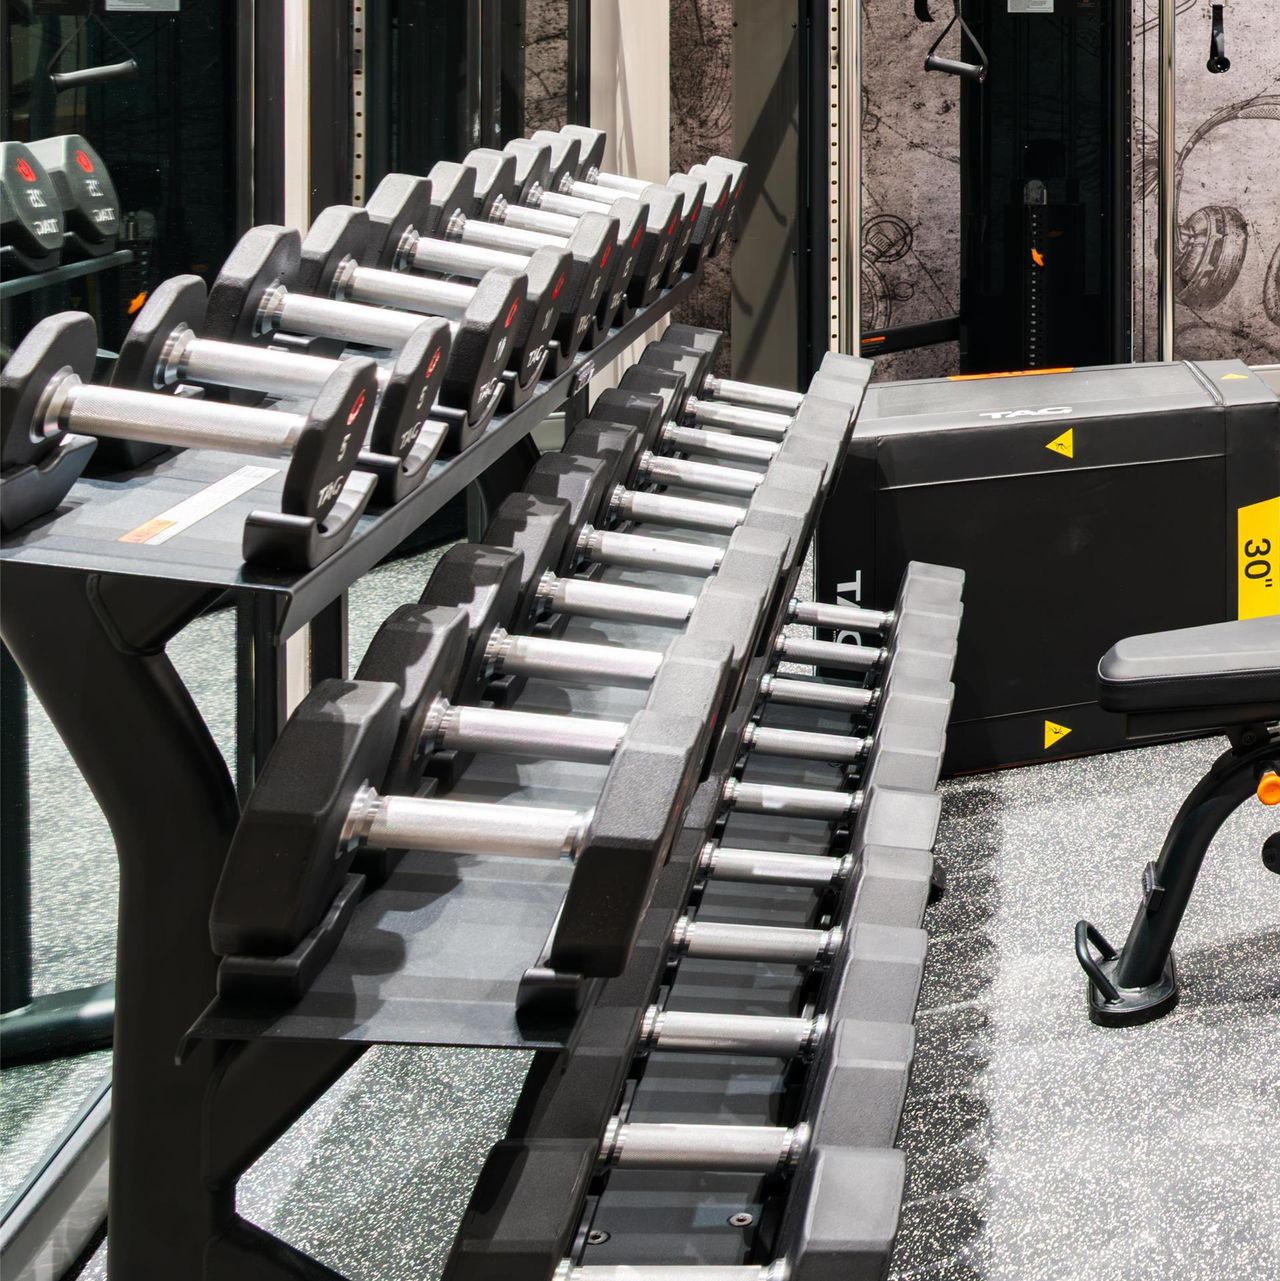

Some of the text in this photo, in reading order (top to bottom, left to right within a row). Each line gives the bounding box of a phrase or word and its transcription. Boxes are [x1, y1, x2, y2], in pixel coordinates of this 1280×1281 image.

[416, 385, 428, 410] 5
[979, 406, 1073, 419] TAG
[336, 432, 352, 463] 5
[399, 421, 422, 450] TAG
[317, 474, 344, 509] TAG
[1244, 538, 1273, 588] 30"
